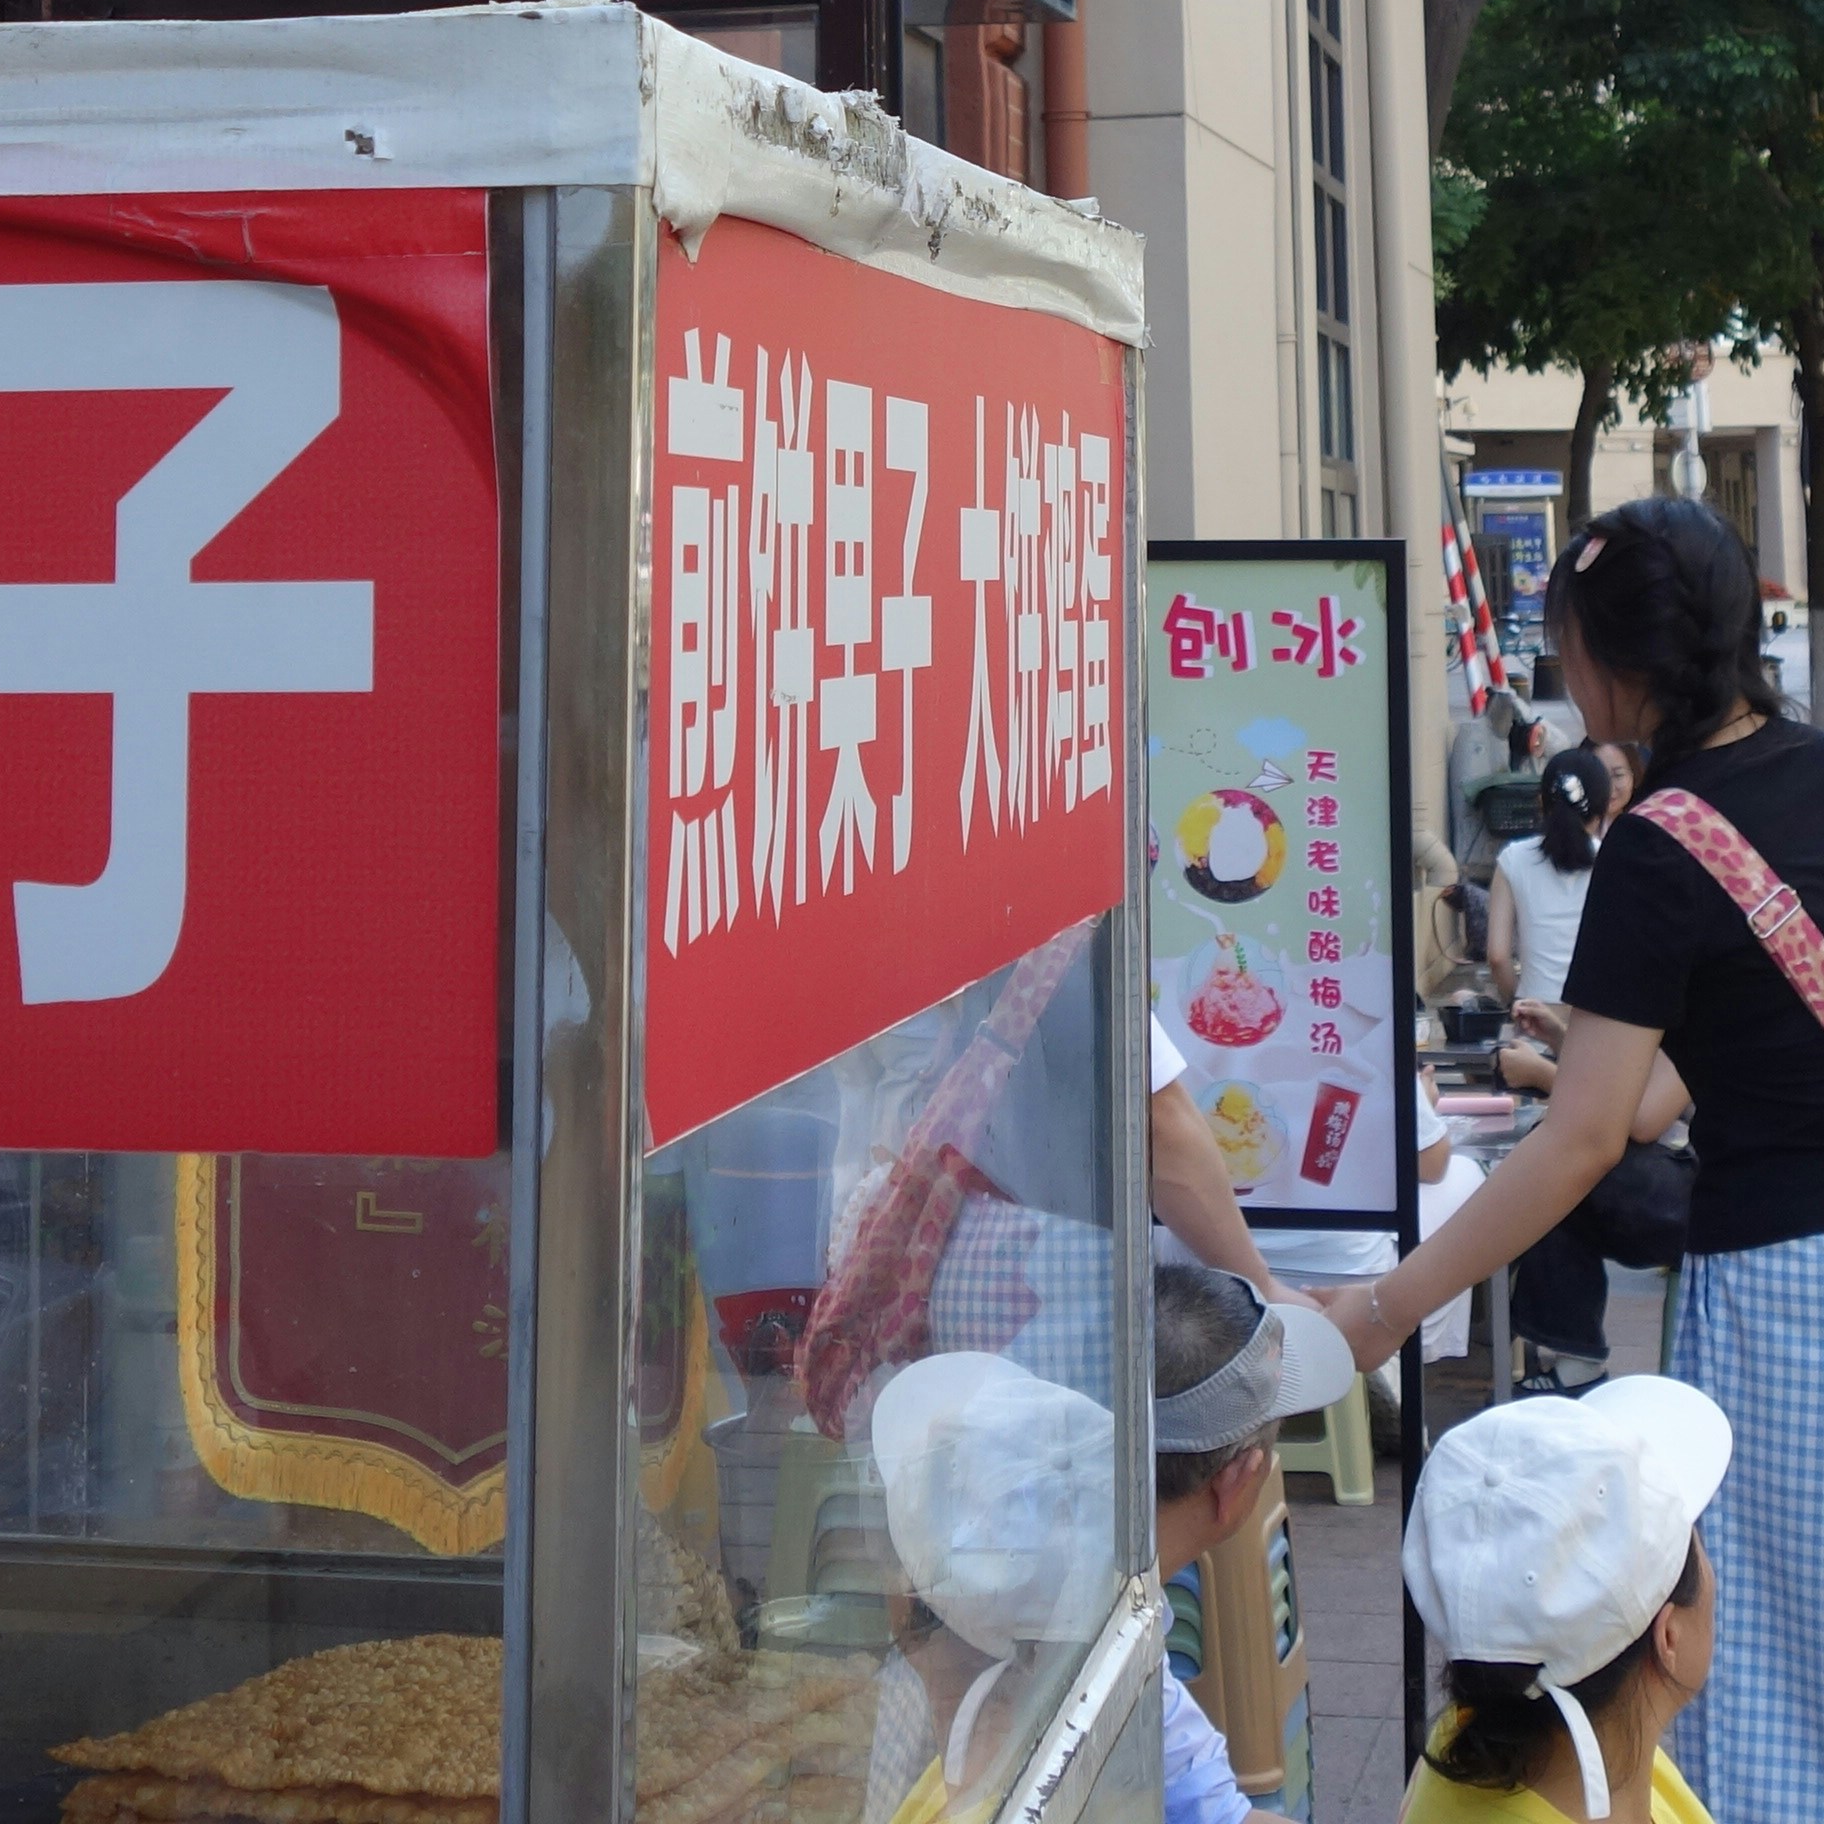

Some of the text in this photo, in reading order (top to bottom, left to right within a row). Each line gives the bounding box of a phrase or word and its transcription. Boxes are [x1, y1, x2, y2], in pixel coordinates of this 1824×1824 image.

[663, 326, 1112, 959] 煎饼果子 大饼鸡蛋
[1162, 593, 1366, 680] 刨冰
[1306, 750, 1343, 1057] 天津老味酸梅汤
